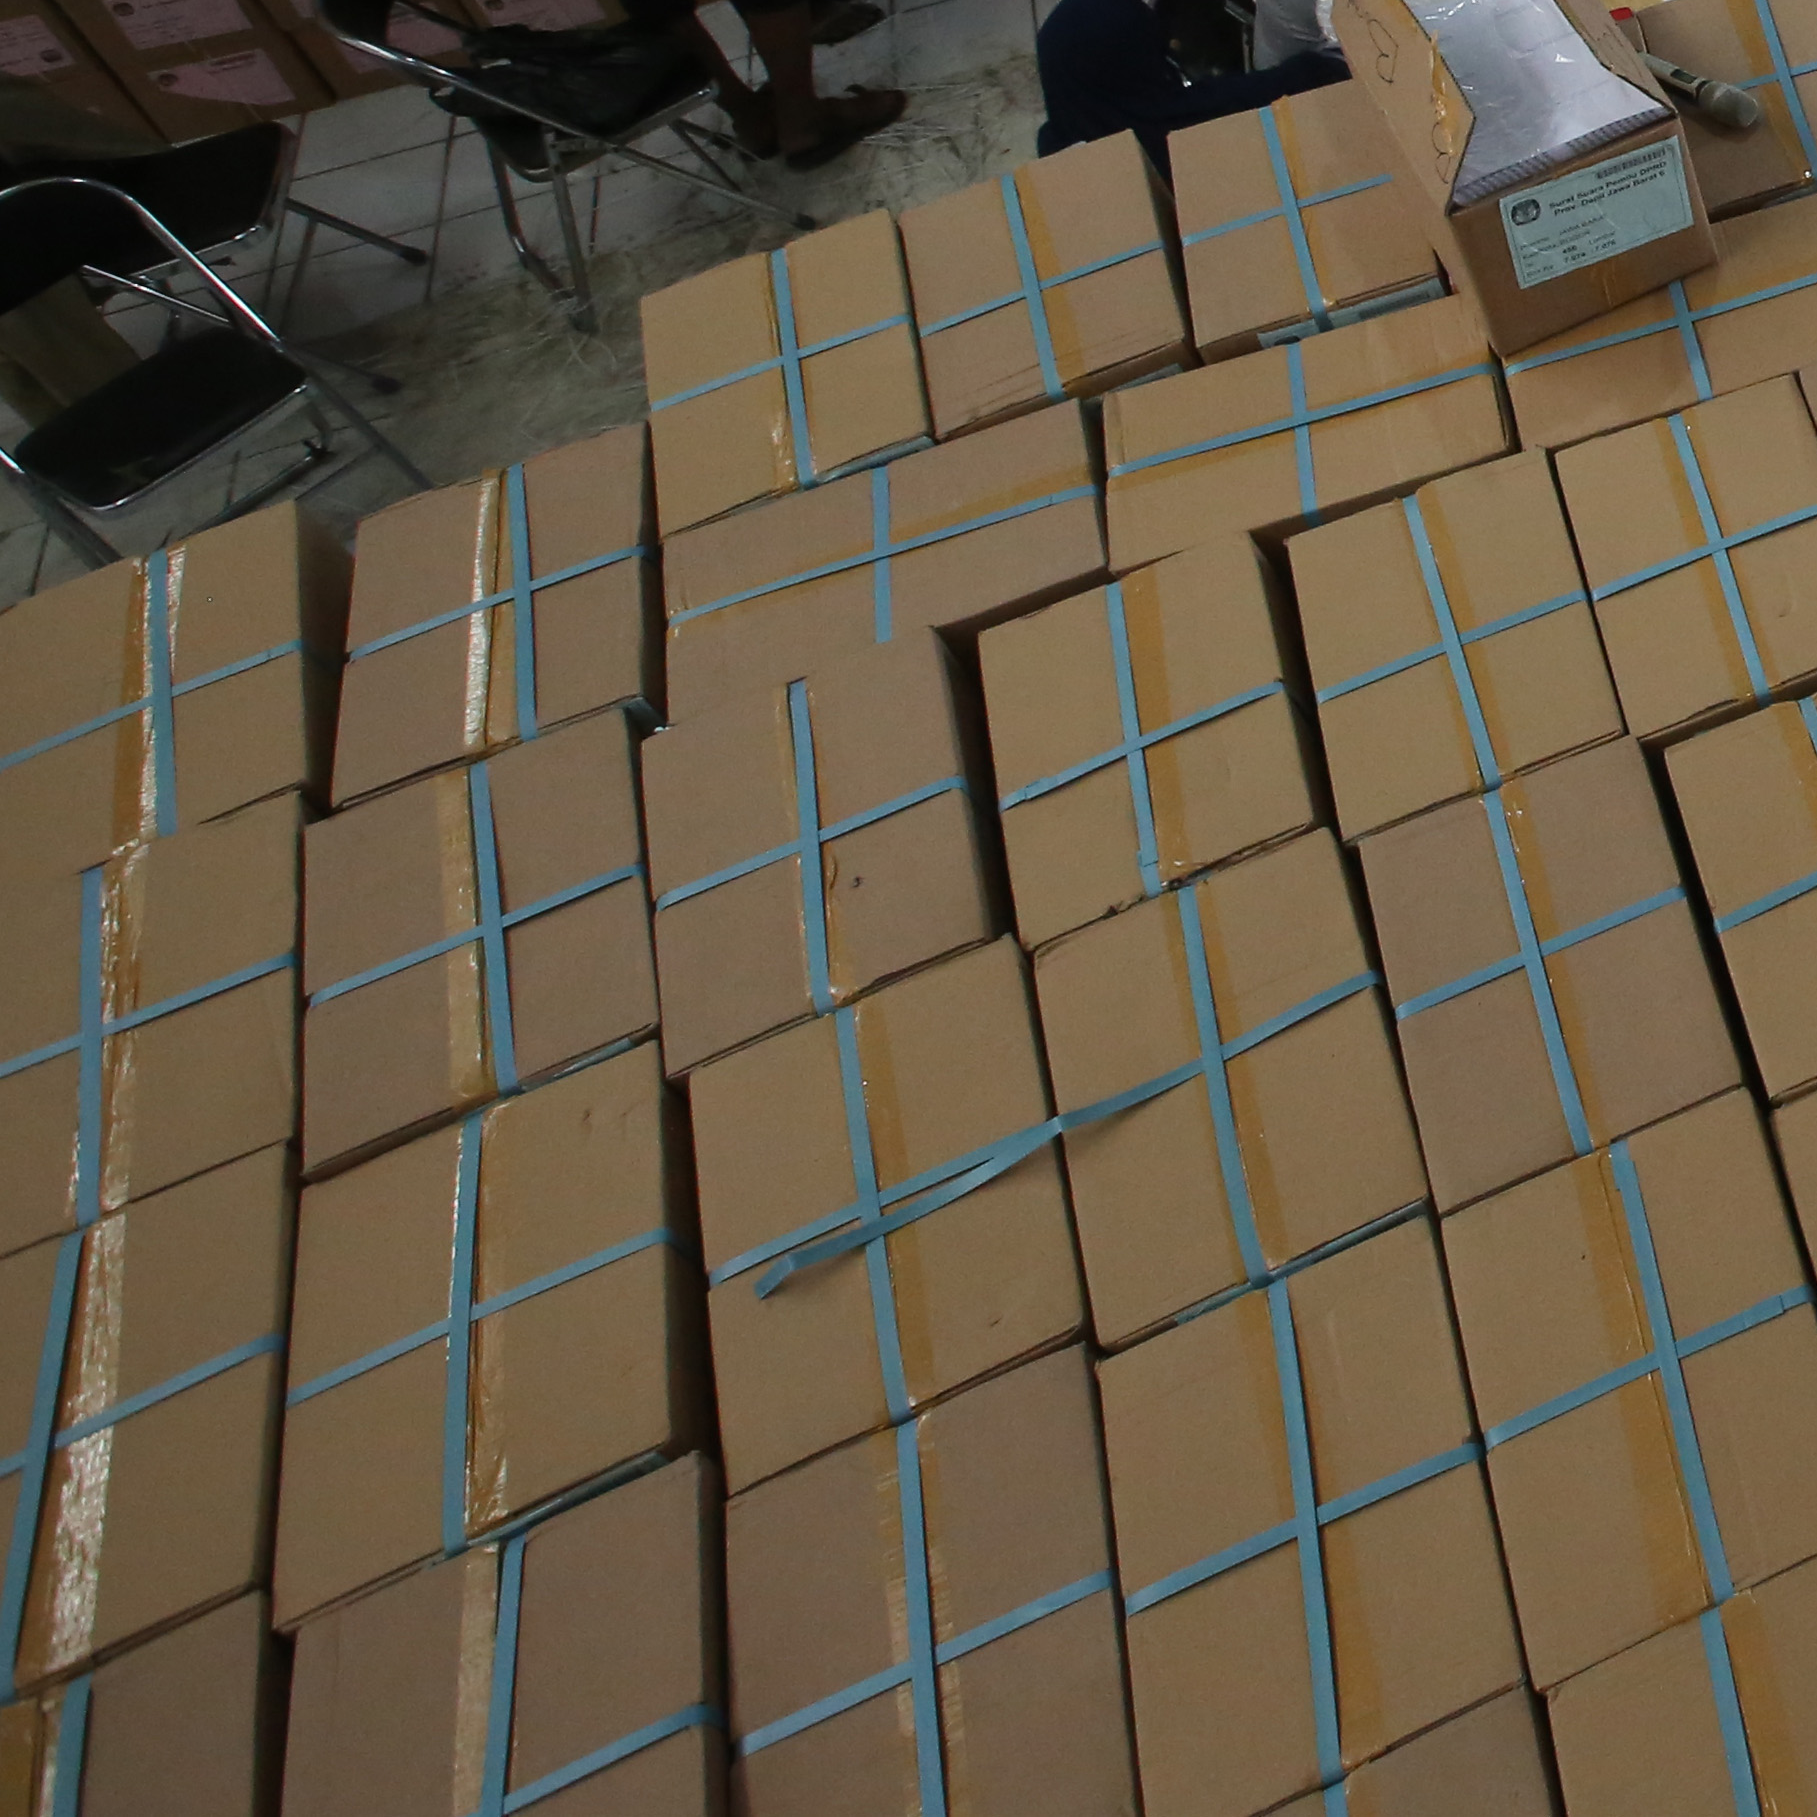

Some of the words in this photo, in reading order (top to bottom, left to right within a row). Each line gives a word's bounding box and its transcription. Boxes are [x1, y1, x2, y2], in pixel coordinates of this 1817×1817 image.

[1549, 195, 1575, 209] Surat
[1576, 185, 1604, 199] Suara
[1639, 160, 1667, 176] DPRD
[1607, 183, 1631, 197] Jawa
